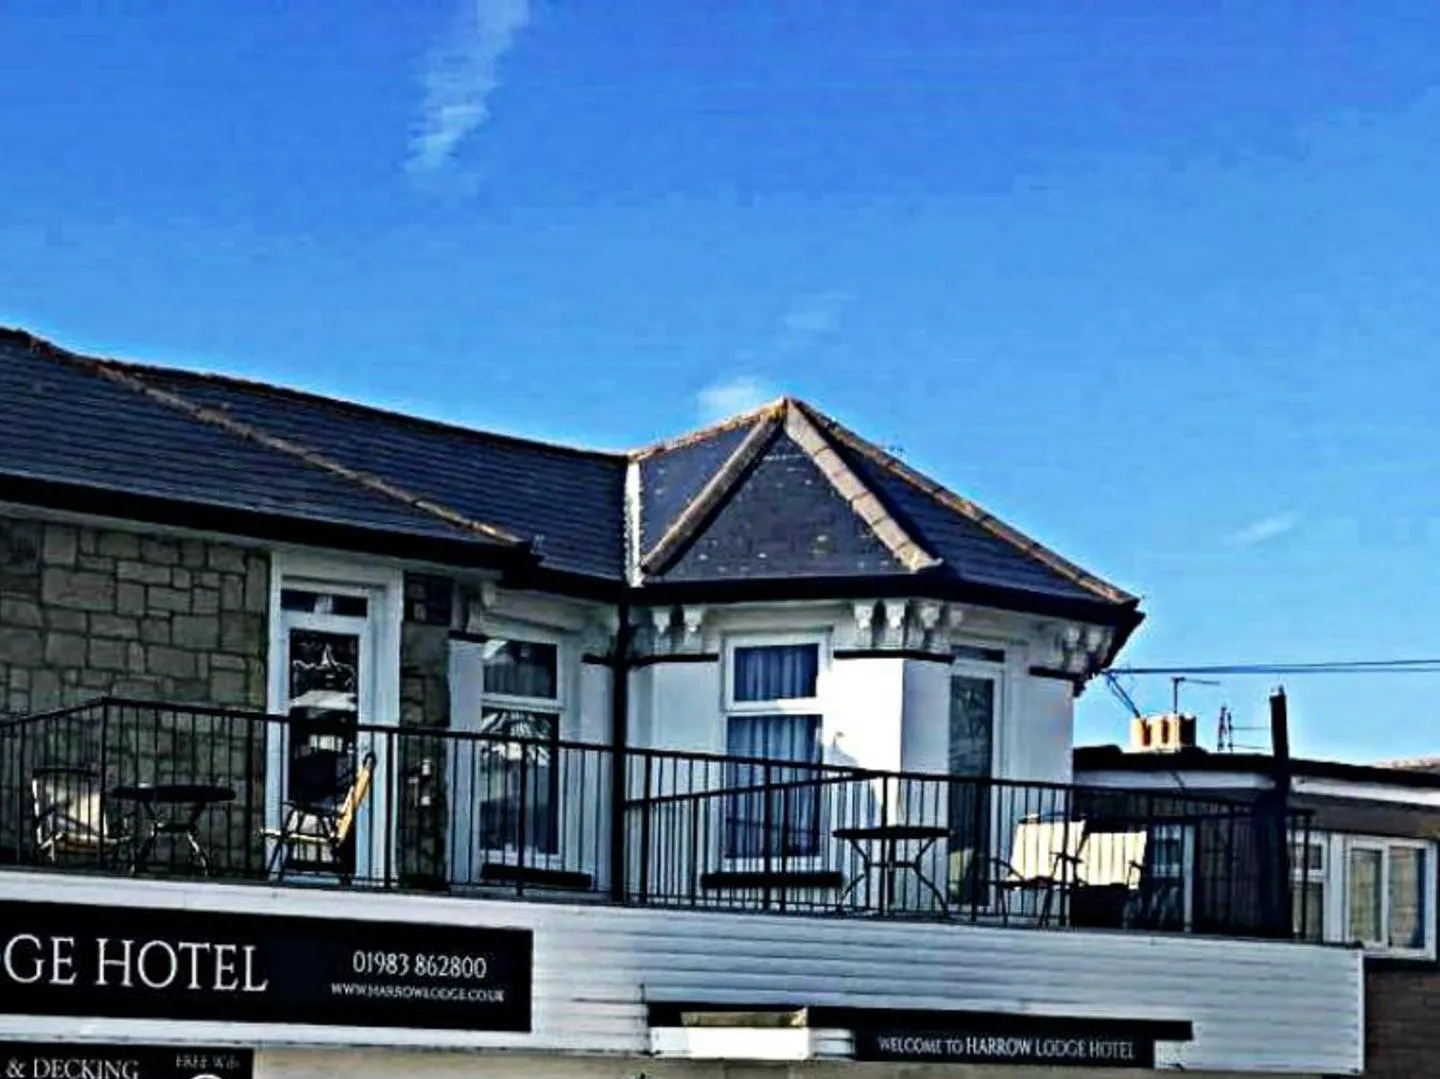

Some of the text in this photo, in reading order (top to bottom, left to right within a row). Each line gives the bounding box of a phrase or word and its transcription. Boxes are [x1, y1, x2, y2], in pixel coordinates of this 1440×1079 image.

[96, 937, 268, 993] HOTEL
[352, 949, 487, 980] 01983 862800
[878, 1036, 1135, 1060] WELCOME TO HARROW LODGE HOTEL
[5, 1057, 26, 1078] &
